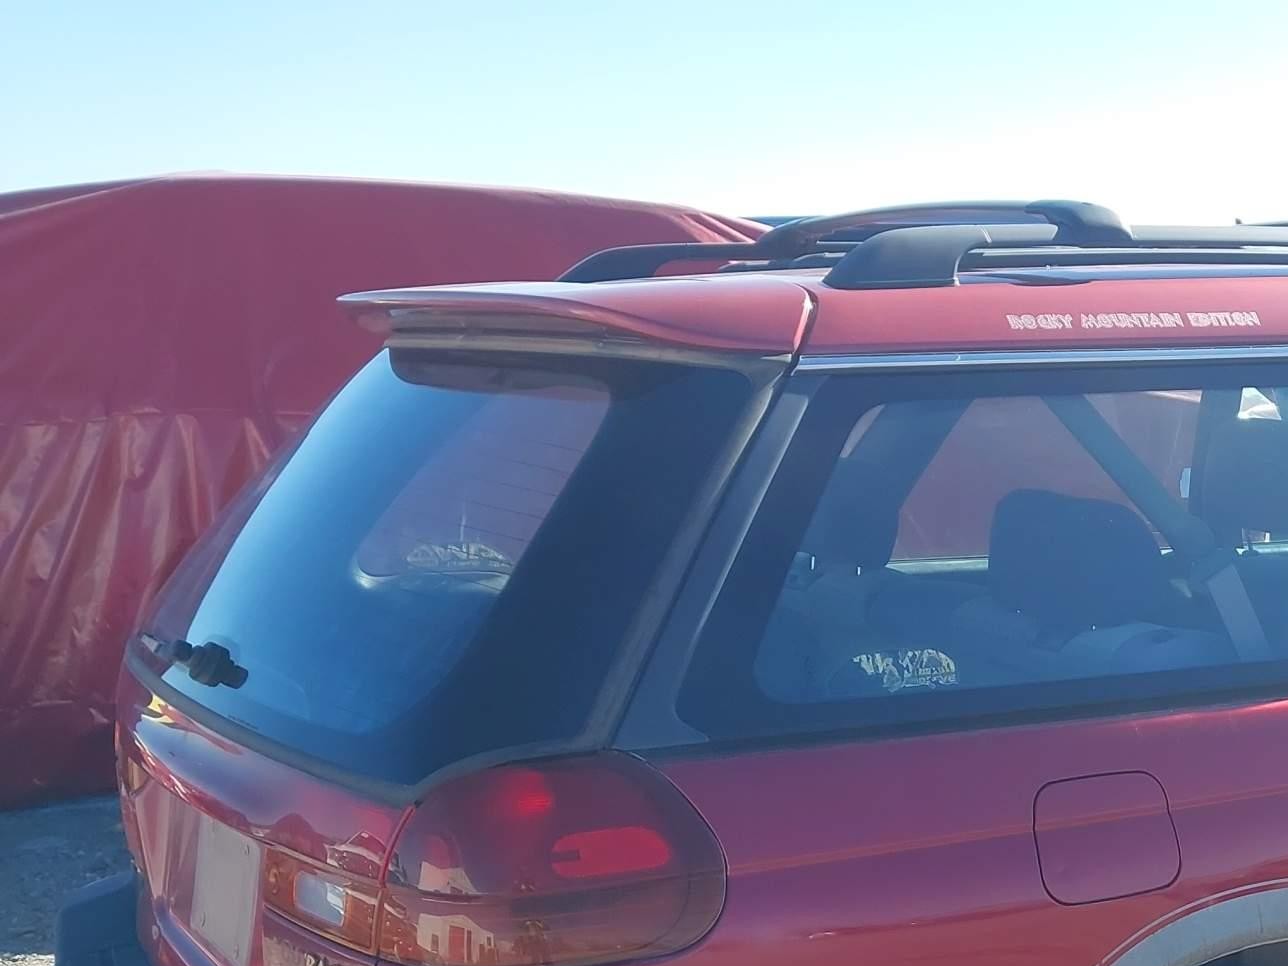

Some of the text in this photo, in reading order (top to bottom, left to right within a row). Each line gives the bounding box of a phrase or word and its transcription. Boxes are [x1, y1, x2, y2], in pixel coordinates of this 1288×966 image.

[1006, 311, 1262, 330] ROCKY MOUNTAIN EDITION
